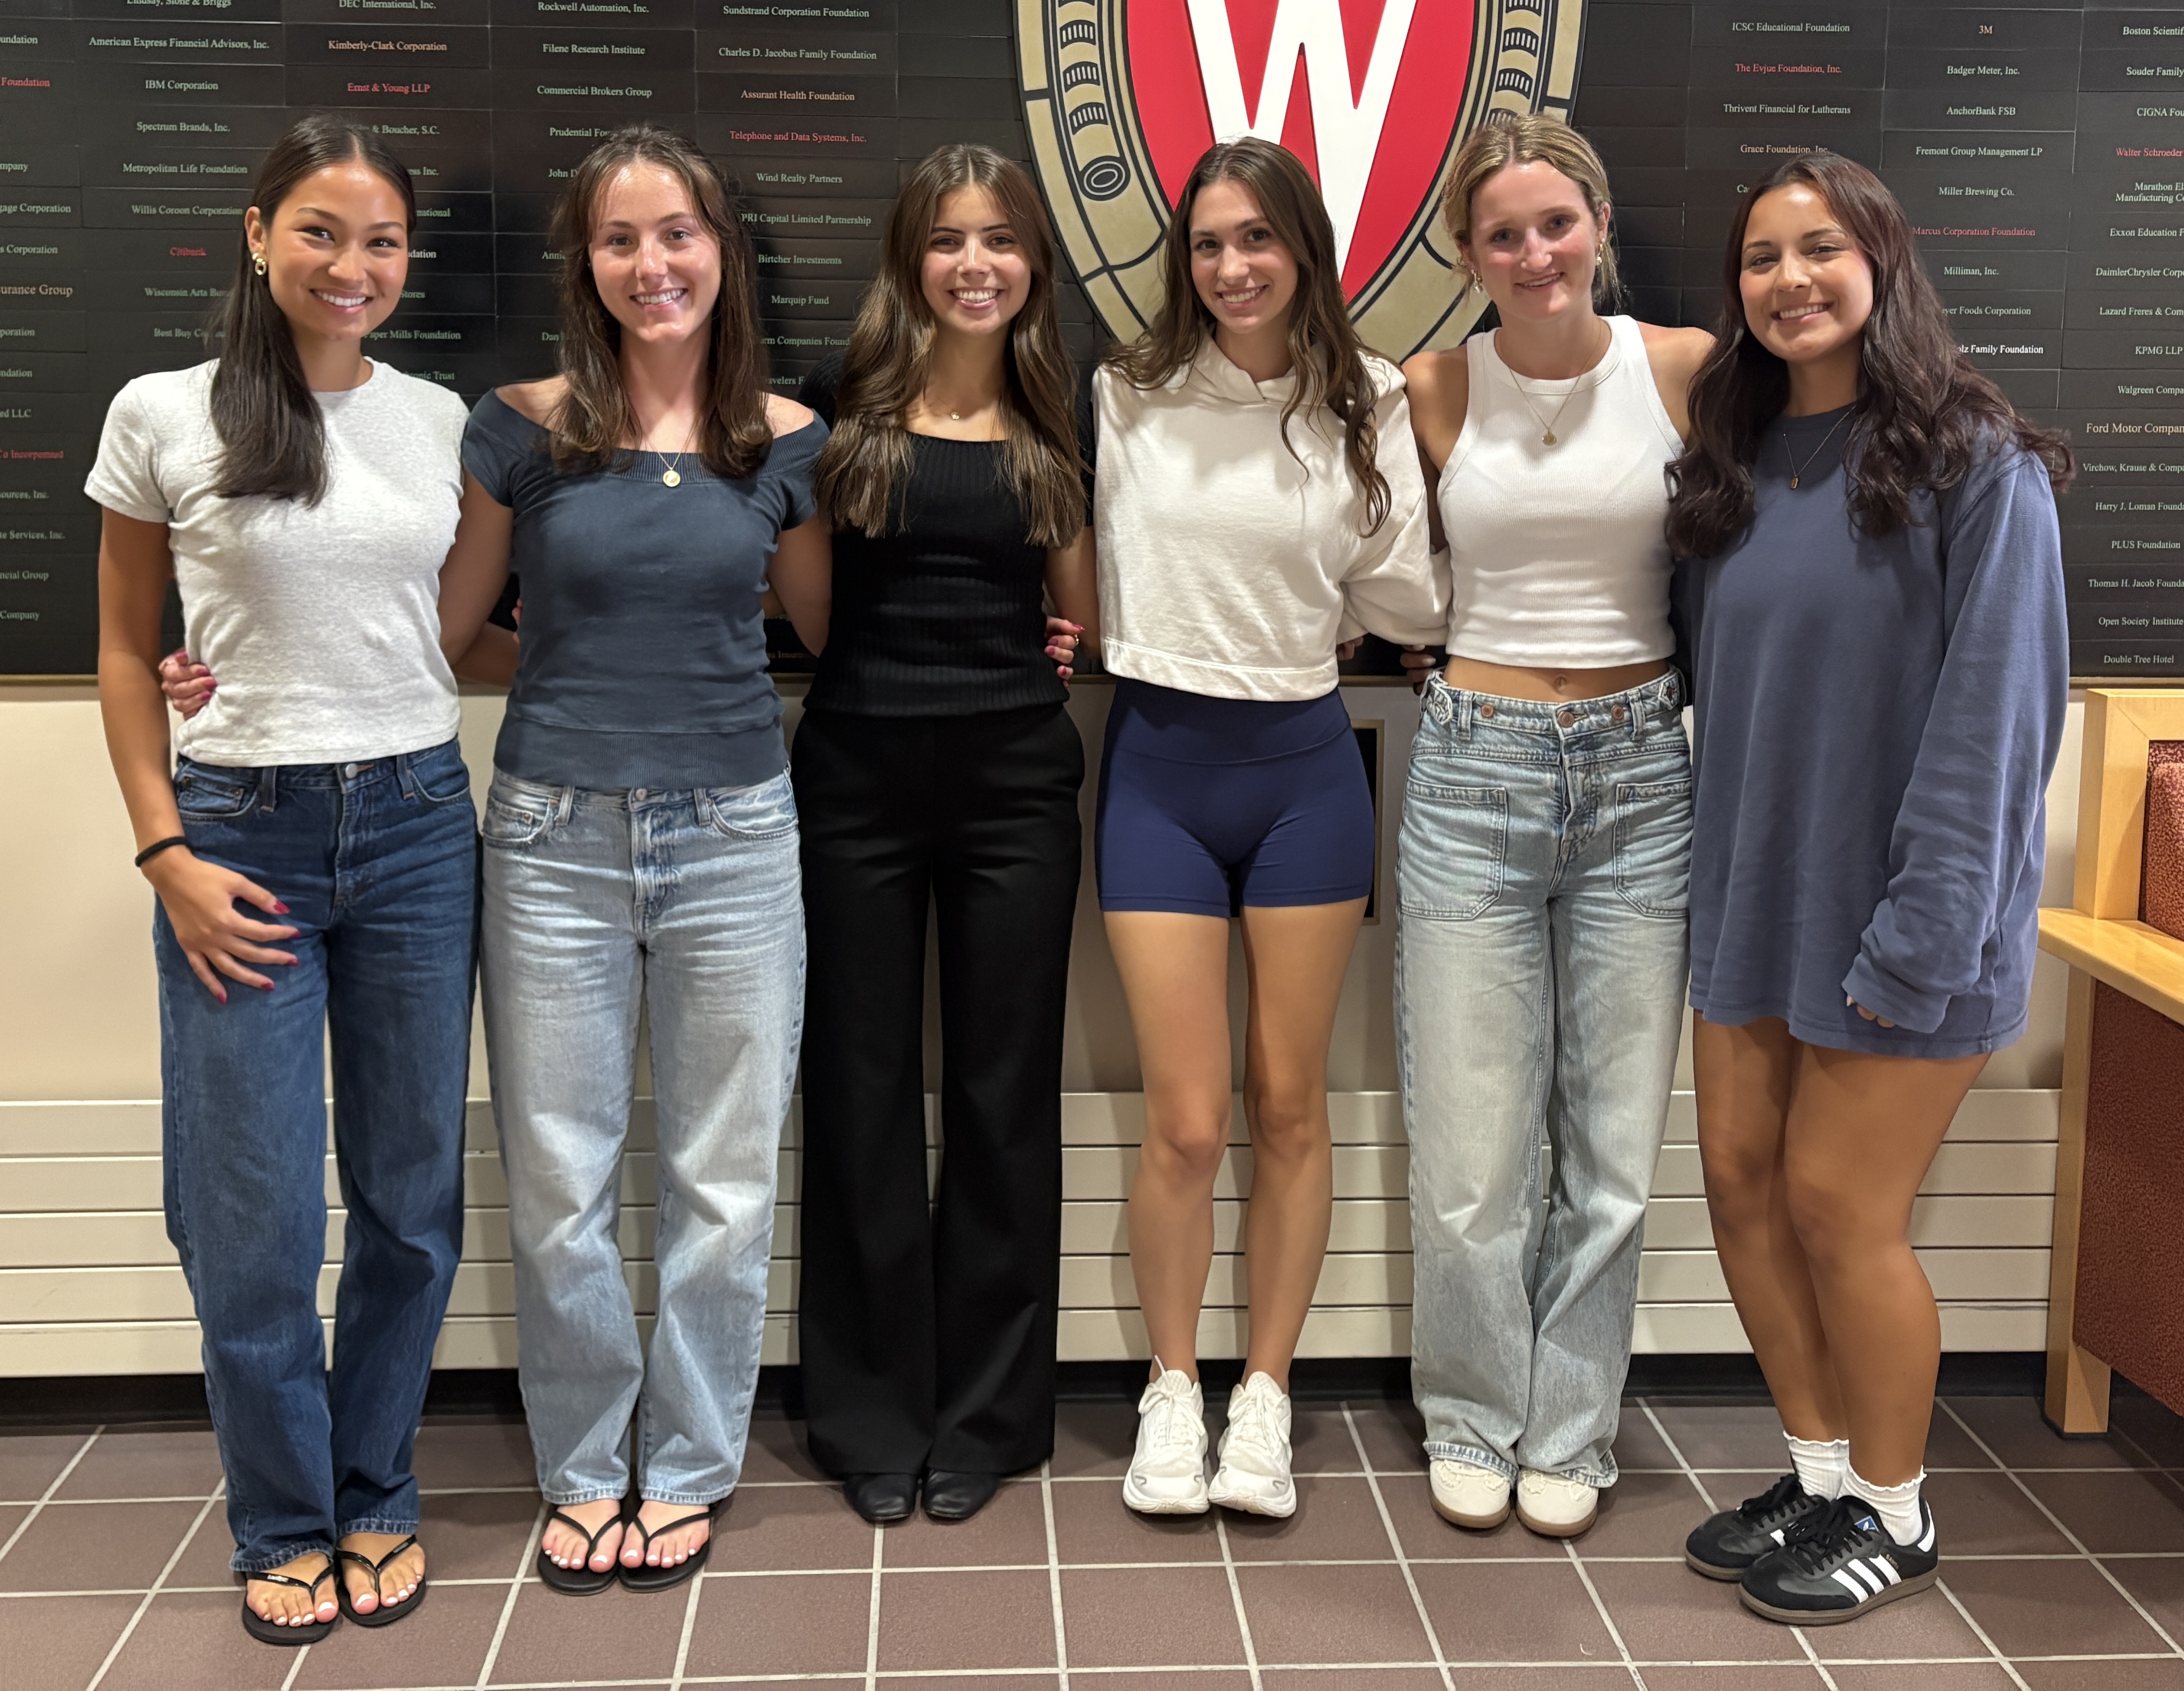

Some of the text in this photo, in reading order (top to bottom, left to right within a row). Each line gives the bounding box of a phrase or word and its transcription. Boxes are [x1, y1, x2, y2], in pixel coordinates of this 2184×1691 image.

[339, 0, 436, 10] DEC International, Inc.
[538, 2, 650, 14] Rockwell Automation, Inc.
[723, 5, 870, 18] Sundstrand Corporation Foundation
[1732, 22, 1850, 32] ICSC Educational Foundation
[1979, 25, 1993, 34] 3M
[2122, 26, 2151, 36] Boston
[88, 37, 270, 49] American Express Financial Advisors, Inc.
[328, 40, 448, 52] Kimberly-Clark Corporation
[543, 43, 645, 54] Filene Research Institute
[718, 47, 877, 61] Charles D. Jacobus Family Foundation
[1735, 63, 1842, 74] The Evjue Foundation, Inc.
[1947, 65, 2020, 76] Badger Meter, Inc.
[2126, 67, 2184, 78] Souder Family
[1, 77, 50, 87] Foundation
[145, 79, 219, 92] IBM Corporation
[347, 82, 431, 95] Ernst & Young LLP
[537, 85, 653, 99] Commercial Brokers Group
[741, 90, 855, 101] Assurant Health Foundation
[1723, 104, 1851, 114] Thrivent Financial for Lutherans
[1946, 106, 2016, 115] AnchorBank FSB
[2137, 107, 2168, 116] CIGNA
[136, 121, 230, 133] Spectrum Brands, Inc.
[381, 125, 440, 135] Boucher, S.C.
[549, 127, 592, 137] Prudential
[729, 131, 867, 143] Telephone and Data Systems, Inc.
[1186, 0, 1419, 283] W
[1740, 144, 1764, 153] Grace
[1916, 146, 2043, 158] Fremont Group Management LP
[2116, 147, 2183, 157] Walter Schroeder
[123, 163, 248, 175] Metropolitan Life Foundation
[423, 166, 439, 175] Inc.
[548, 168, 568, 177] John
[756, 173, 843, 185] Wind Realty Partners
[2135, 182, 2173, 191] Marathon
[1939, 187, 2015, 198] Miller Brewing Co.
[2115, 193, 2174, 204] Manufacturing
[19, 203, 71, 215] Corporation
[131, 204, 157, 215] Willis
[759, 214, 789, 225] Capital
[791, 214, 823, 224] Limited
[825, 215, 871, 227] Partnership
[1912, 227, 2035, 238] Marcus Corporation Foundation
[2110, 228, 2135, 236] Exxon
[2137, 228, 2177, 236] Education
[6, 244, 58, 256] Corporation
[758, 254, 842, 264] Birtcher Investments
[1944, 266, 1999, 276] Milliman, Inc.
[2096, 267, 2162, 278] DaimlerChrysler
[39, 284, 73, 298] Group
[771, 295, 830, 306] Marquip Fund
[1959, 306, 2031, 317] Foods Corporation
[2100, 307, 2127, 315] Lazard
[2129, 307, 2153, 315] Freres
[2155, 307, 2163, 316] &
[390, 330, 461, 340] Mills Foundation
[542, 332, 560, 342] Dan
[777, 336, 823, 347] Companies
[1970, 344, 2044, 355] Family Foundation
[2135, 346, 2183, 355] KPMG LLP
[2117, 385, 2154, 396] Walgreen
[11, 408, 32, 418] LLC
[2086, 423, 2142, 433] Ford Motor
[2083, 463, 2157, 472] Virchow, Krause &
[33, 490, 49, 499] Inc.
[2096, 501, 2156, 513] Harry J. Loman
[9, 530, 47, 540] Services,
[49, 530, 66, 540] Inc.
[2111, 540, 2181, 549] PLUS Foundation
[22, 570, 49, 582] Group
[2088, 579, 2155, 587] Thomas H. Jacob
[0, 610, 40, 621] Company
[2098, 617, 2184, 628] Open Society Institute
[2104, 655, 2174, 664] Double Tree Hotel
